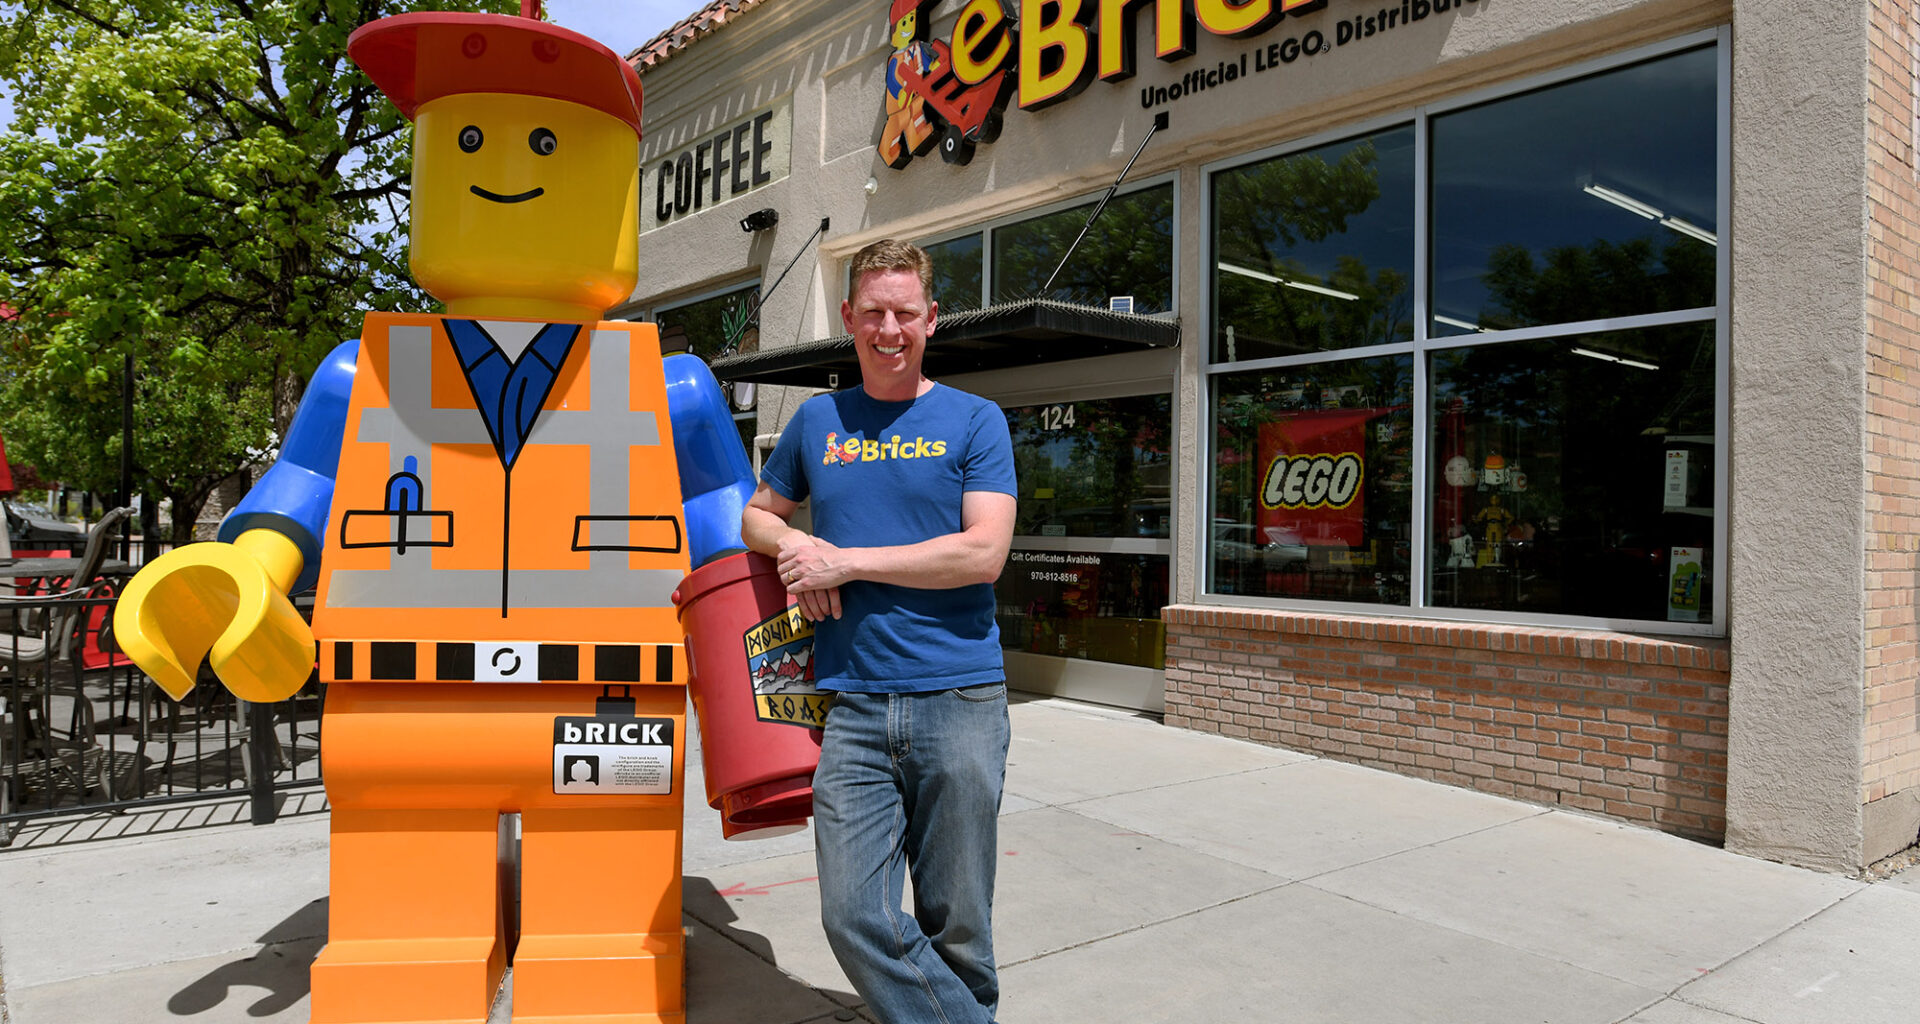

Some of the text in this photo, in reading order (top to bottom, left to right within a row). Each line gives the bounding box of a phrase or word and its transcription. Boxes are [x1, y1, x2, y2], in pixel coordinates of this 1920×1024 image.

[1141, 53, 1247, 109] Unofficial
[1336, 0, 1480, 46] Distribu
[656, 110, 773, 221] COFFEE
[1040, 404, 1076, 431] 124
[843, 435, 947, 462] eBricks
[1262, 453, 1362, 508] LEGO
[1011, 552, 1101, 565] Gift Certificates Available
[1030, 571, 1078, 582] 970-812-8516
[563, 722, 664, 744] bRICK
